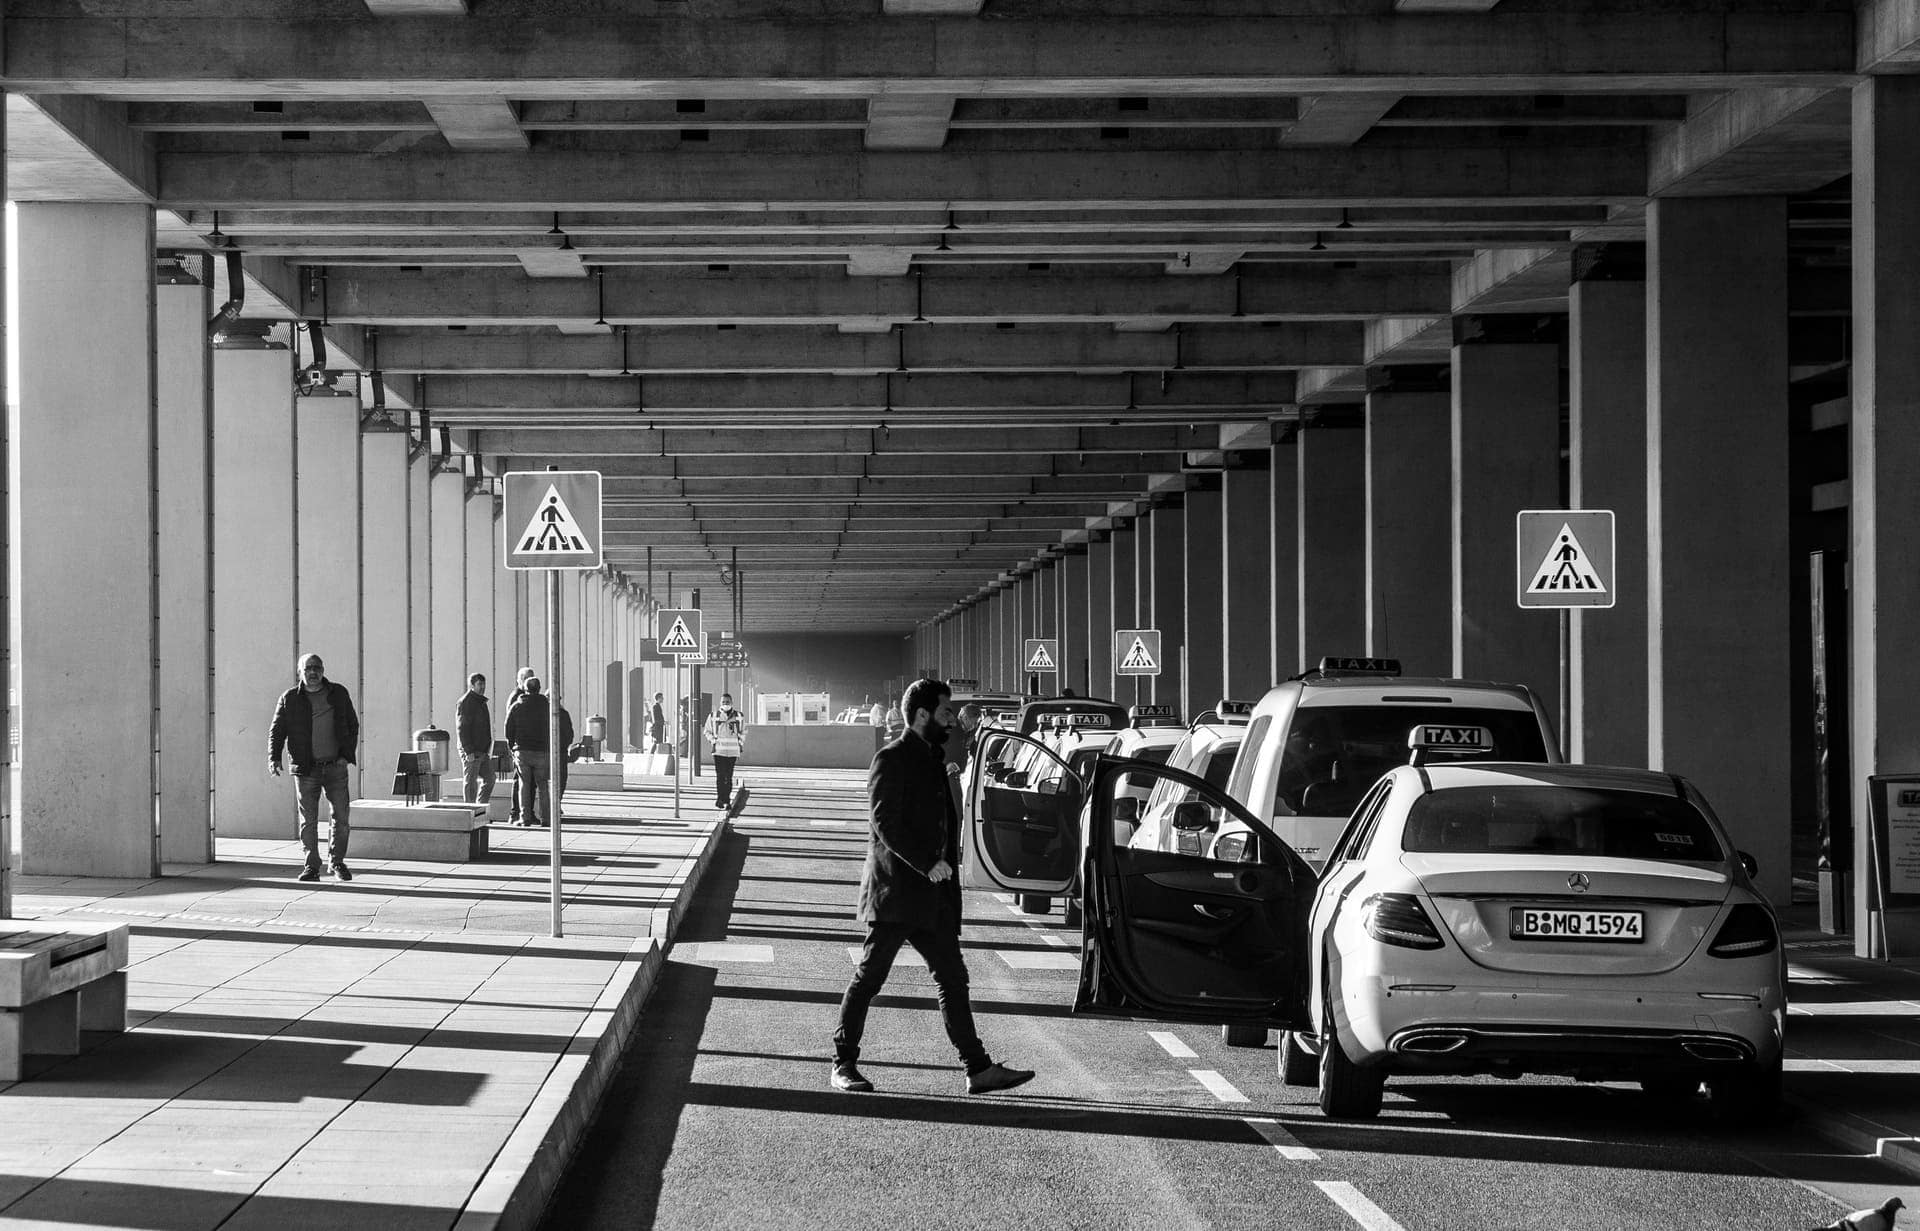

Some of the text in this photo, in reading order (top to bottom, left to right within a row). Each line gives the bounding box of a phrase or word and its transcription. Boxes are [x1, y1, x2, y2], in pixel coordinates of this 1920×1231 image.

[1335, 659, 1388, 670] TAXI
[1139, 706, 1169, 715] TAXI
[1230, 703, 1252, 713] TA
[1076, 715, 1103, 724] TAXI
[1427, 729, 1479, 743] TAXI
[1525, 912, 1539, 933] B
[1553, 913, 1581, 935] MQ
[1585, 914, 1639, 936] 1594
